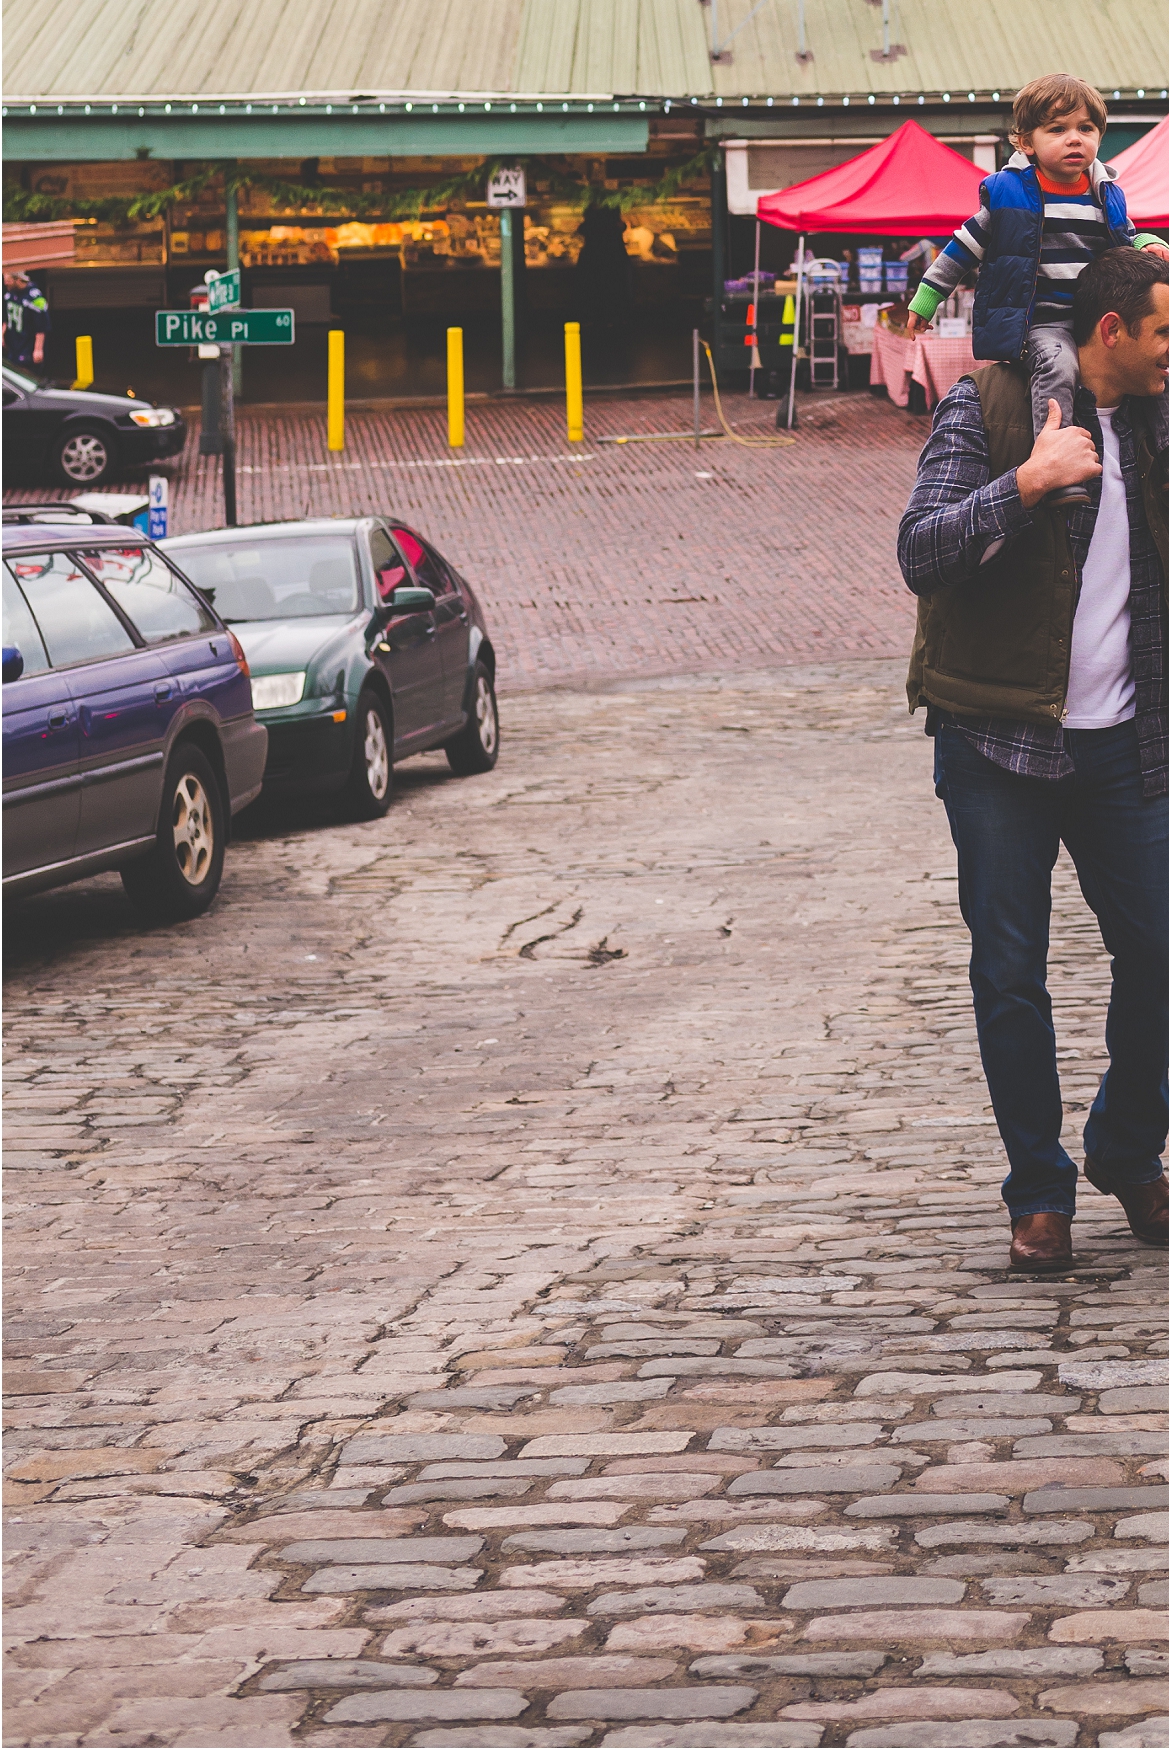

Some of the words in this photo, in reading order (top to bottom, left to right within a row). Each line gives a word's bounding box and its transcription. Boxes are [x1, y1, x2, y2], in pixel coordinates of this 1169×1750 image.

[492, 173, 522, 185] WAY
[166, 315, 218, 340] Pike
[231, 322, 248, 339] Pl
[276, 316, 290, 327] 60
